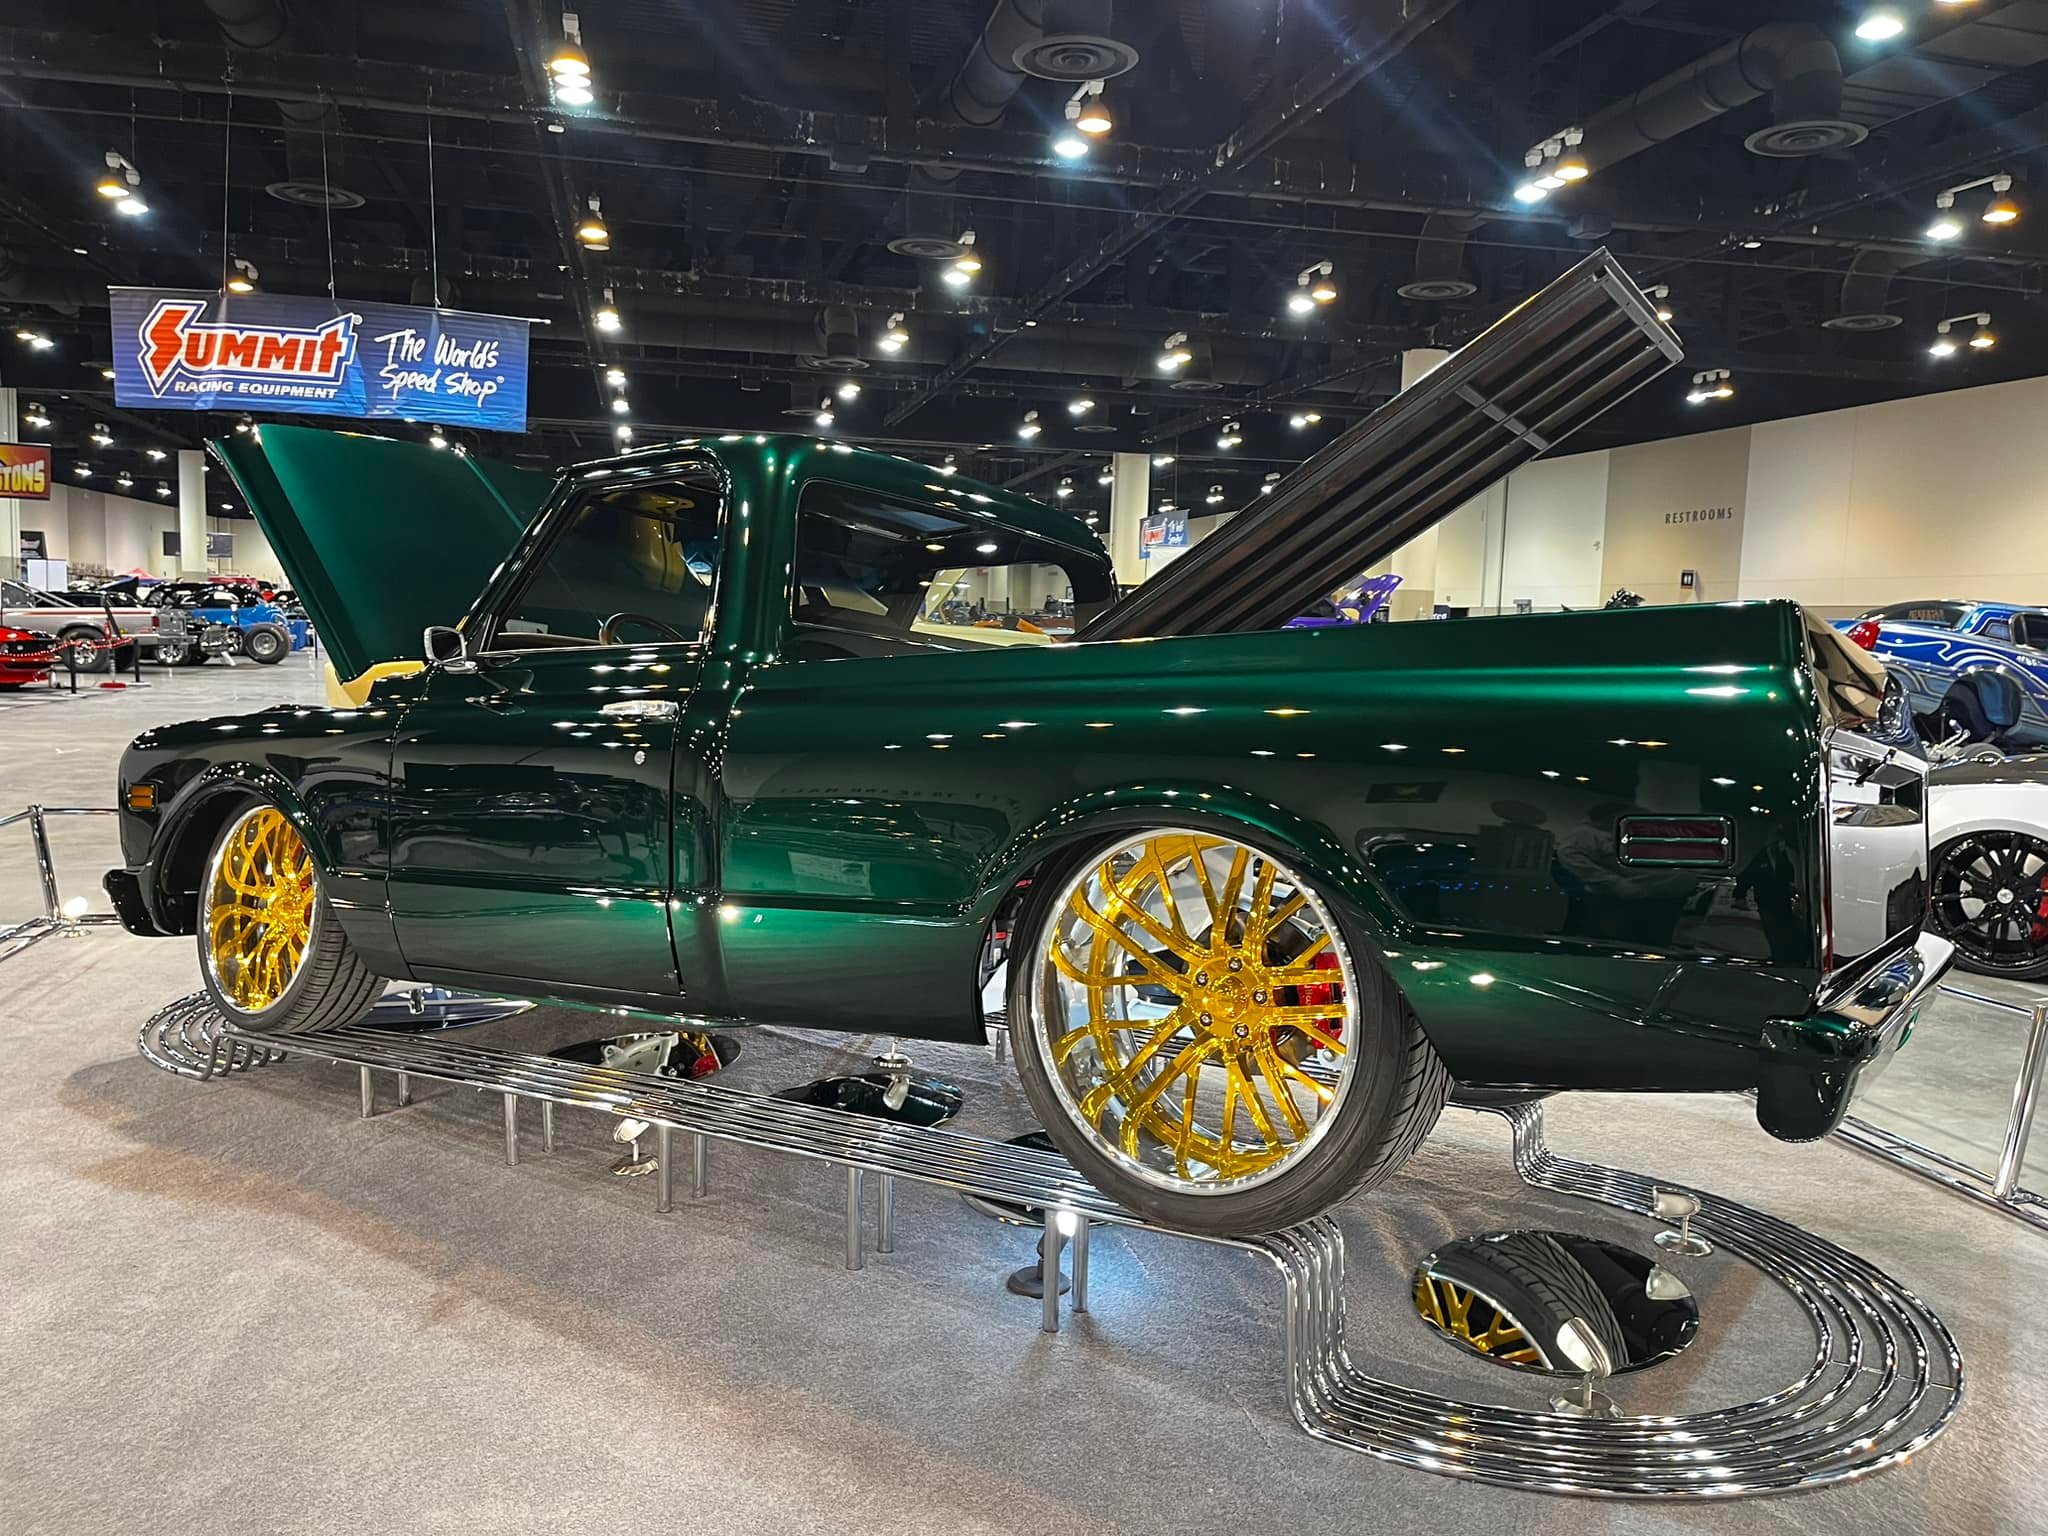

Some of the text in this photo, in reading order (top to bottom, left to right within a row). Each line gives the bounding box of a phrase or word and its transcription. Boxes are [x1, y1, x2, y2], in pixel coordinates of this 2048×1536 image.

[374, 328, 499, 368] The World's
[174, 379, 338, 400] RACING EQUIPMENT
[379, 363, 442, 400] Speed
[1665, 506, 1733, 524] RESTROOMS
